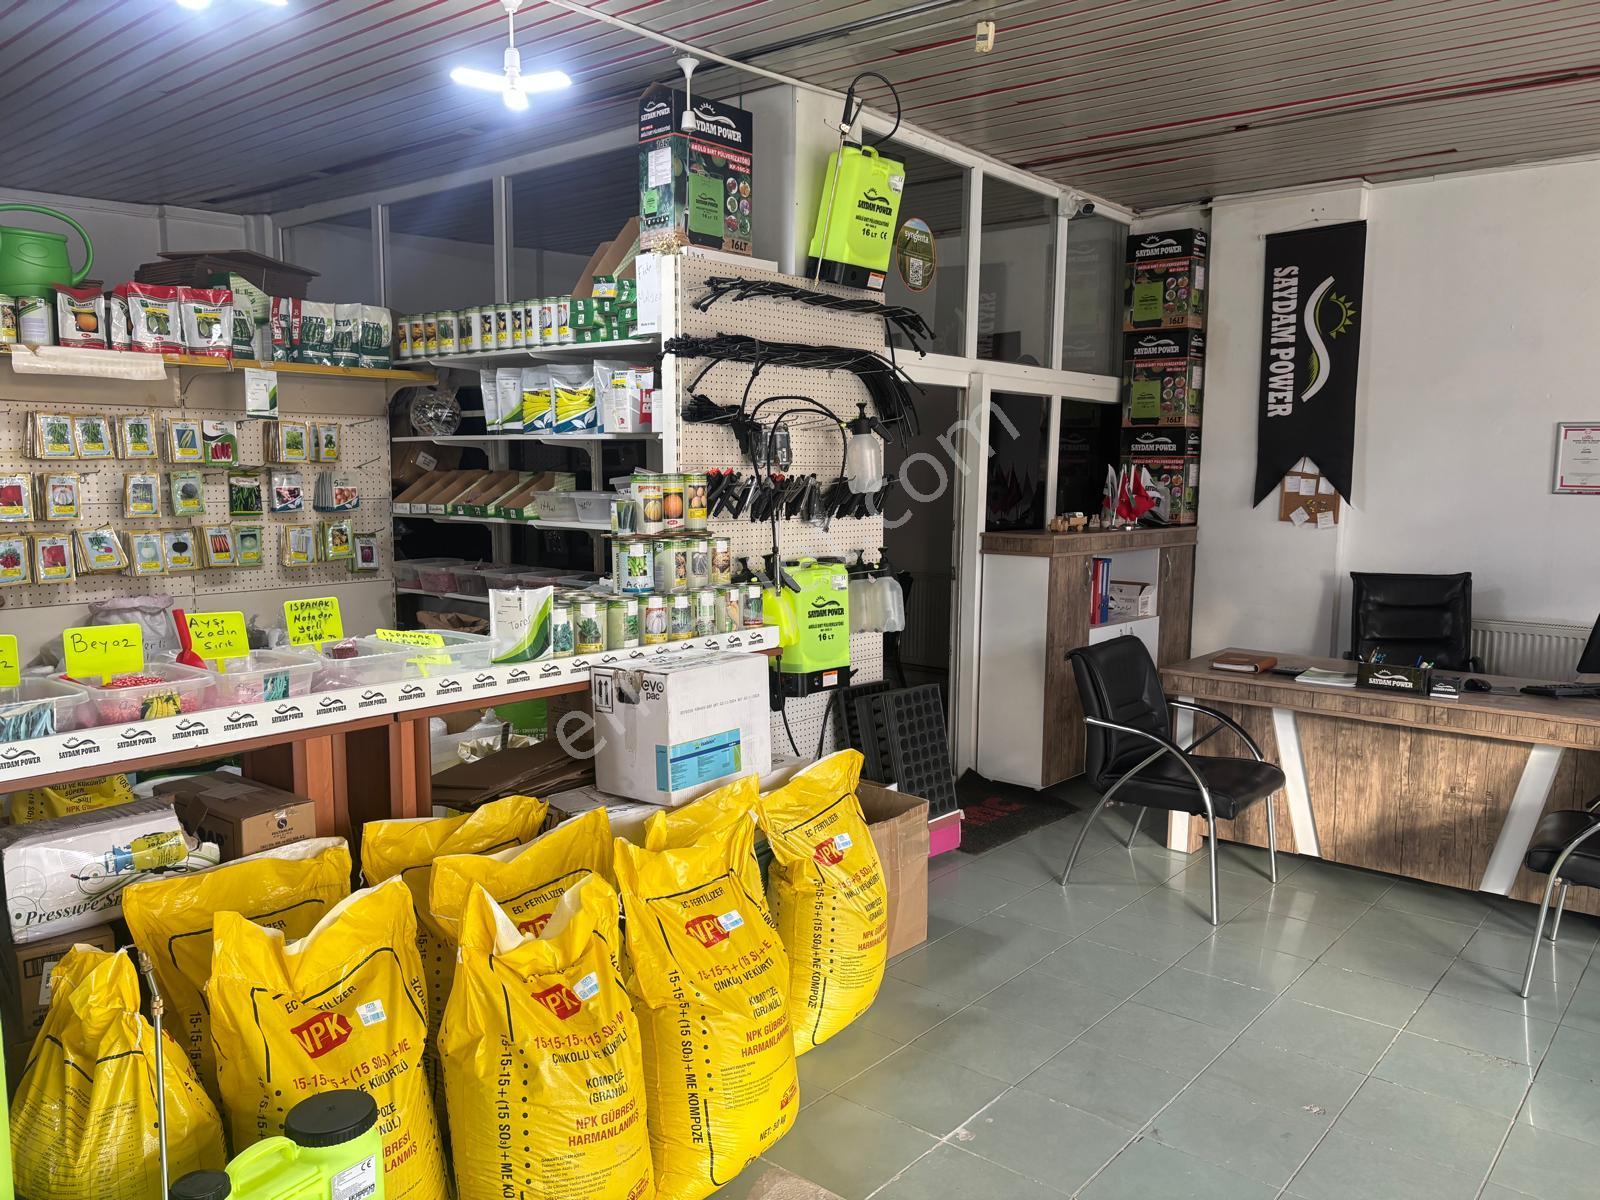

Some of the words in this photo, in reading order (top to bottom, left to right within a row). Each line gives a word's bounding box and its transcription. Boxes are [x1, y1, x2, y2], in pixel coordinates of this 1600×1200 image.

[718, 126, 742, 142] POWER
[876, 204, 892, 216] POWER
[862, 228, 870, 236] 16
[904, 230, 928, 244] syngenta
[731, 240, 748, 252] 16LT
[1136, 248, 1159, 257] SAYDAM
[1160, 246, 1182, 254] POWER
[1270, 265, 1299, 344] SAYDAM
[303, 316, 326, 324] BETA
[274, 317, 282, 339] BETA
[292, 318, 300, 339] BETA
[1134, 347, 1157, 355] SAYDAM
[1158, 346, 1180, 354] POWER
[1267, 348, 1296, 418] POWER
[1131, 444, 1154, 452] SAYDAM
[1155, 444, 1176, 452] POWER
[808, 610, 826, 618] SAYDAM
[828, 608, 844, 616] POWER
[642, 680, 664, 693] evo
[1368, 678, 1392, 686] SAYDAM
[1392, 680, 1412, 688] POWER
[646, 692, 660, 700] pac
[358, 700, 374, 708] SAYDAM
[374, 698, 388, 706] POWER
[316, 707, 332, 716] SAYDAM
[332, 704, 347, 712] POWER
[272, 715, 288, 724] SAYDAM
[288, 712, 304, 721] POWER
[224, 723, 242, 732] SAYDAM
[242, 720, 258, 728] POWER
[172, 731, 192, 740] SAYDAM
[192, 728, 209, 736] POWER
[117, 740, 138, 749] SAYDAM
[140, 736, 156, 746] POWER
[58, 750, 80, 760] SAYDAM
[81, 746, 100, 756] POWER
[20, 756, 40, 766] POWER
[26, 900, 98, 925] Pressure
[512, 906, 524, 914] EC
[808, 973, 820, 1009] KOMPOZE
[285, 1000, 298, 1014] EC
[746, 1028, 762, 1042] NPK
[377, 1102, 397, 1118] POZE
[576, 1116, 598, 1130] NPK
[688, 1092, 704, 1144] KOMPOZE
[568, 1108, 639, 1147] HARMANLANMIŞ
[384, 1131, 411, 1158] BRESİ
[384, 1142, 418, 1173] LANMIŞ
